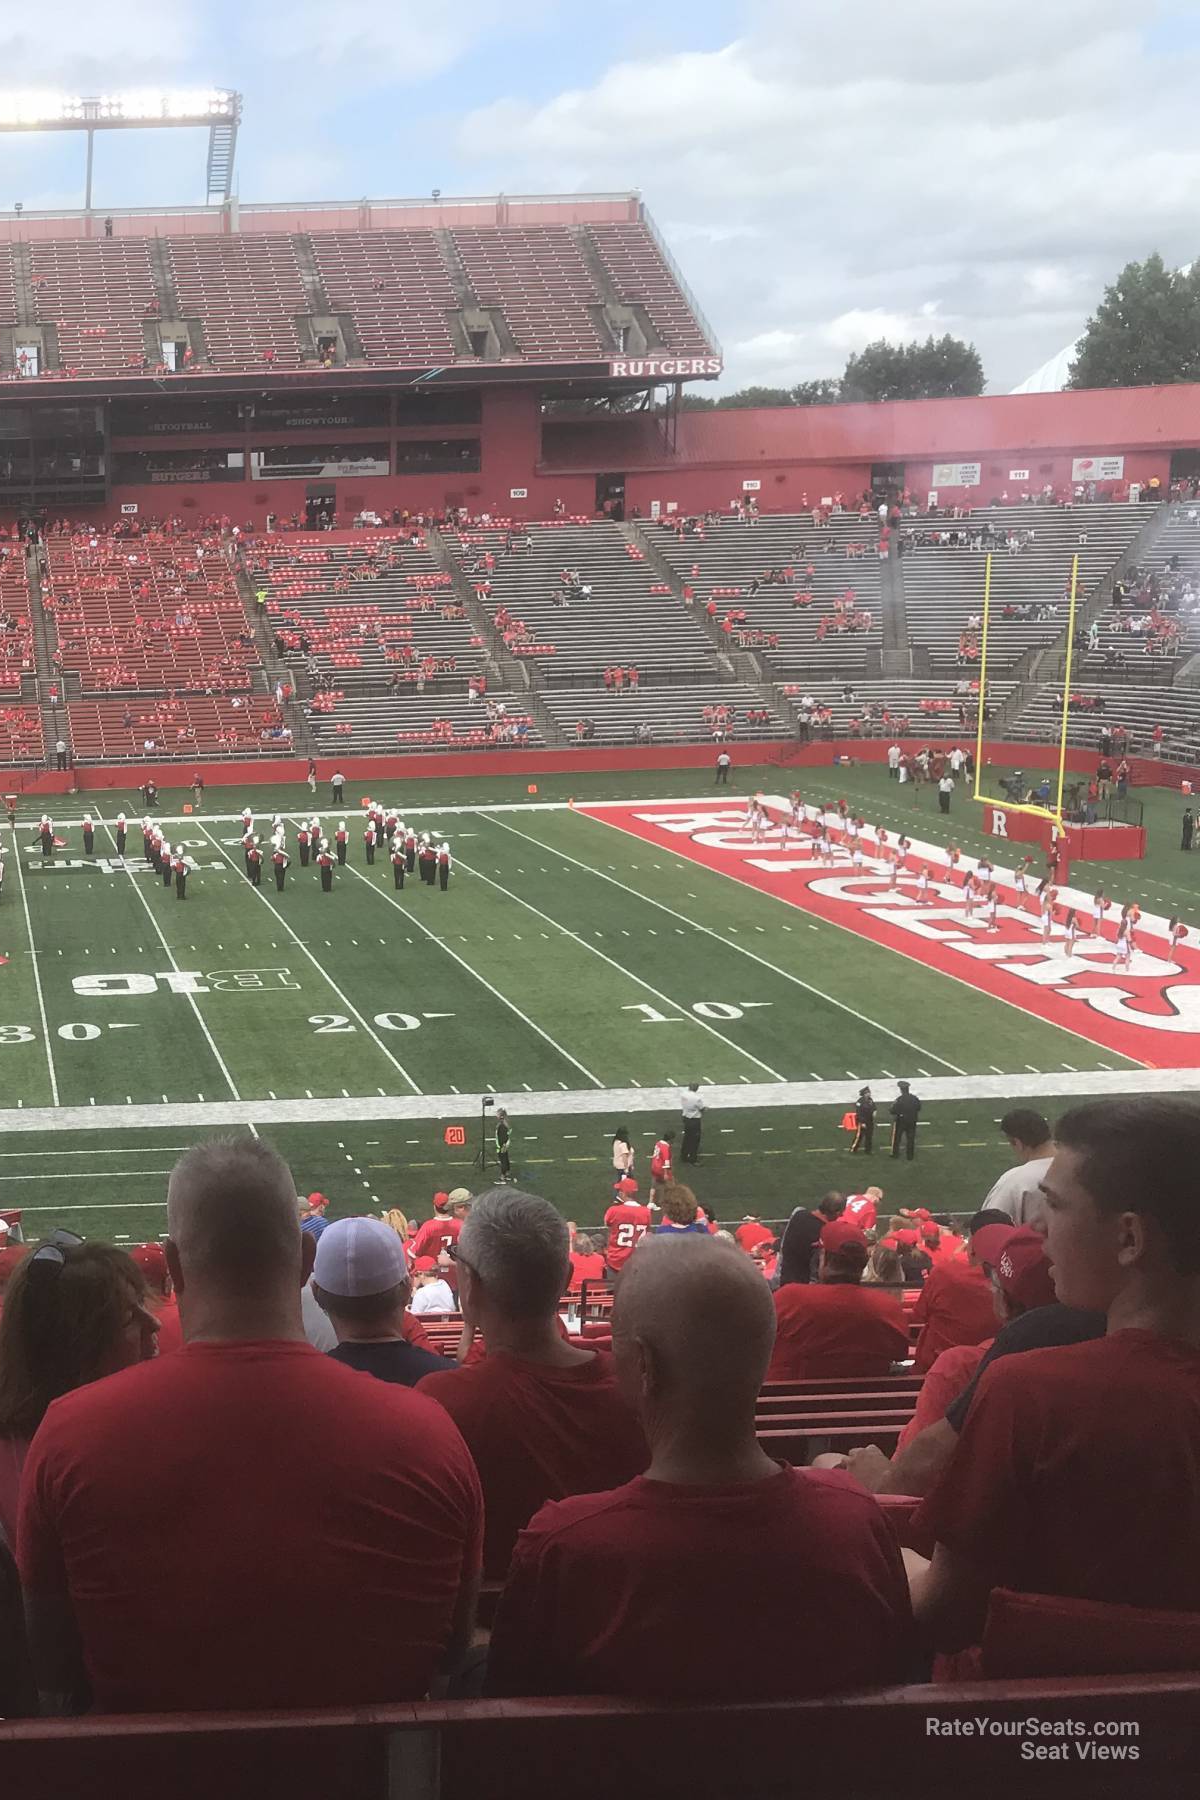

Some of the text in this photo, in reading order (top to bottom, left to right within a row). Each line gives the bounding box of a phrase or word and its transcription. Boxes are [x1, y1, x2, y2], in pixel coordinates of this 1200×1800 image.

[612, 358, 722, 377] RUTGERS
[152, 471, 211, 482] RUTGERS
[992, 810, 1008, 838] R
[449, 1128, 464, 1143] 20
[616, 1223, 648, 1248] 27
